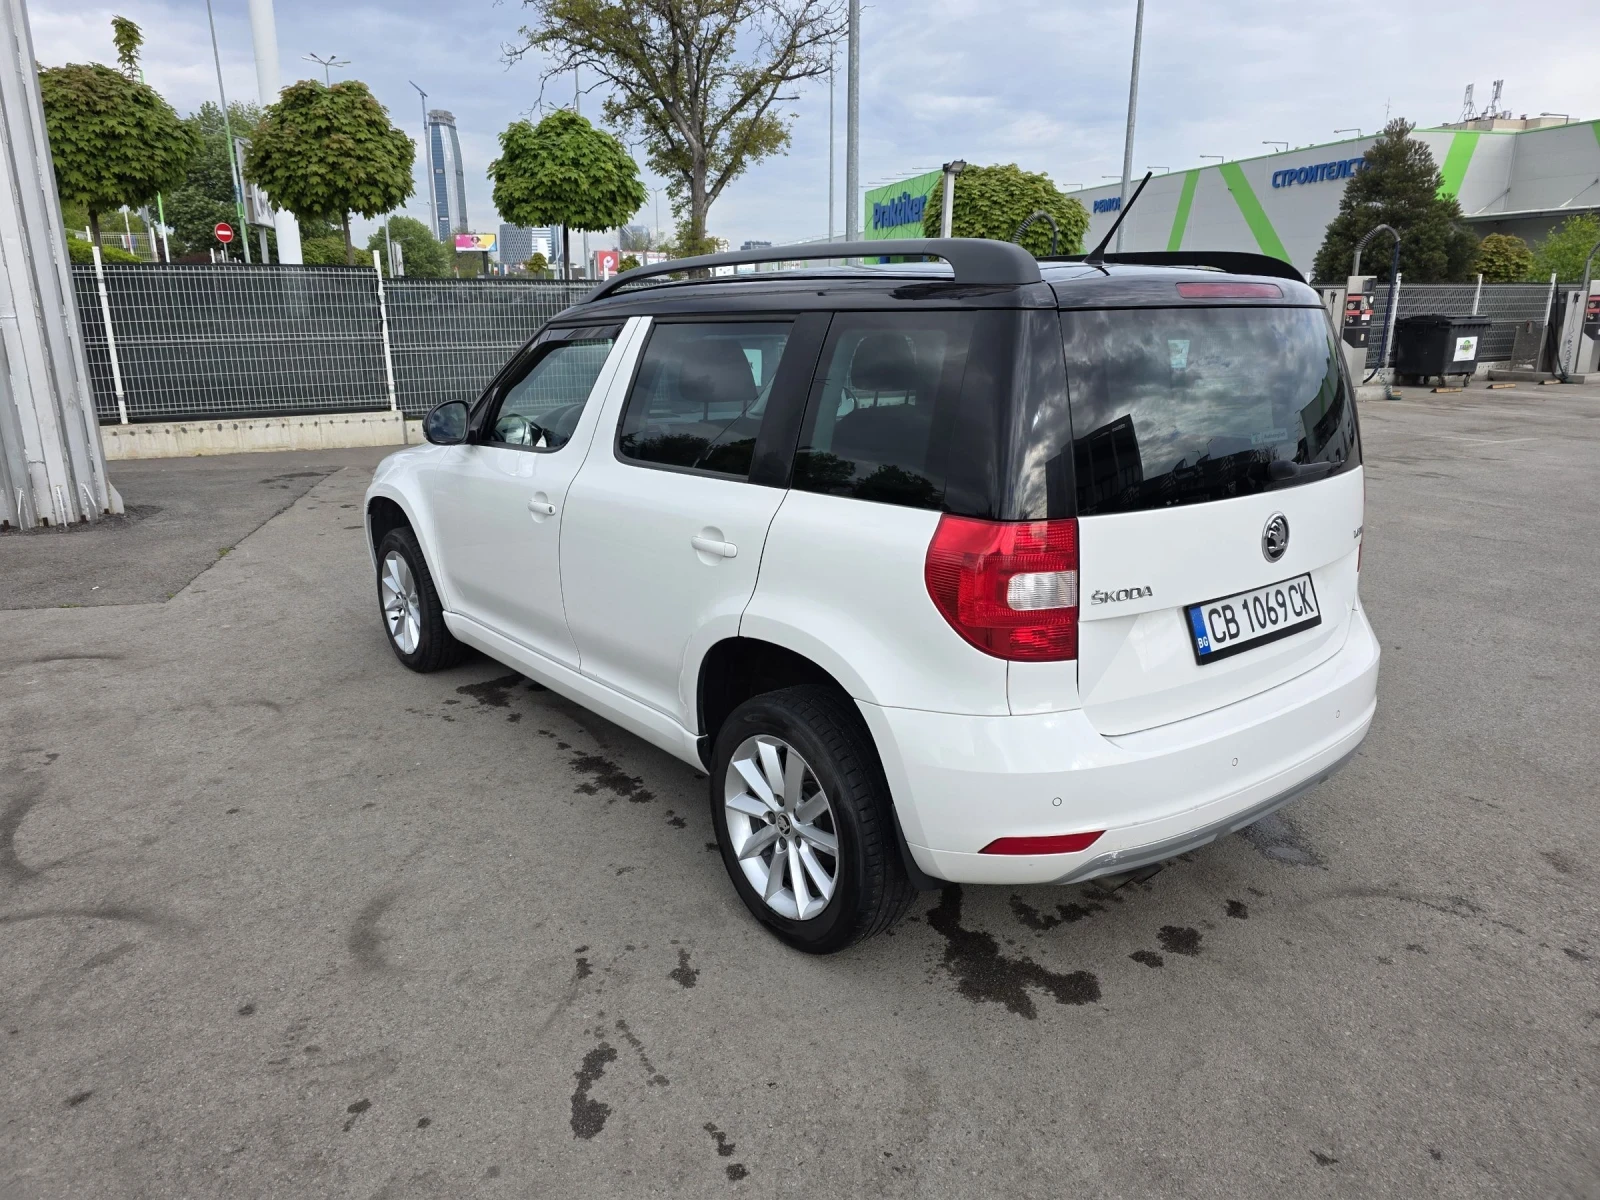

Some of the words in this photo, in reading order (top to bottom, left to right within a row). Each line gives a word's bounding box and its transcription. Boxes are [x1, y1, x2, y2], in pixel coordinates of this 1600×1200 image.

[1272, 157, 1372, 188] СТРОИТЕЛСТ
[873, 191, 927, 230] Praktiker
[1091, 585, 1153, 605] ŠKODA
[1242, 589, 1288, 632] 1069
[1198, 636, 1209, 649] BG
